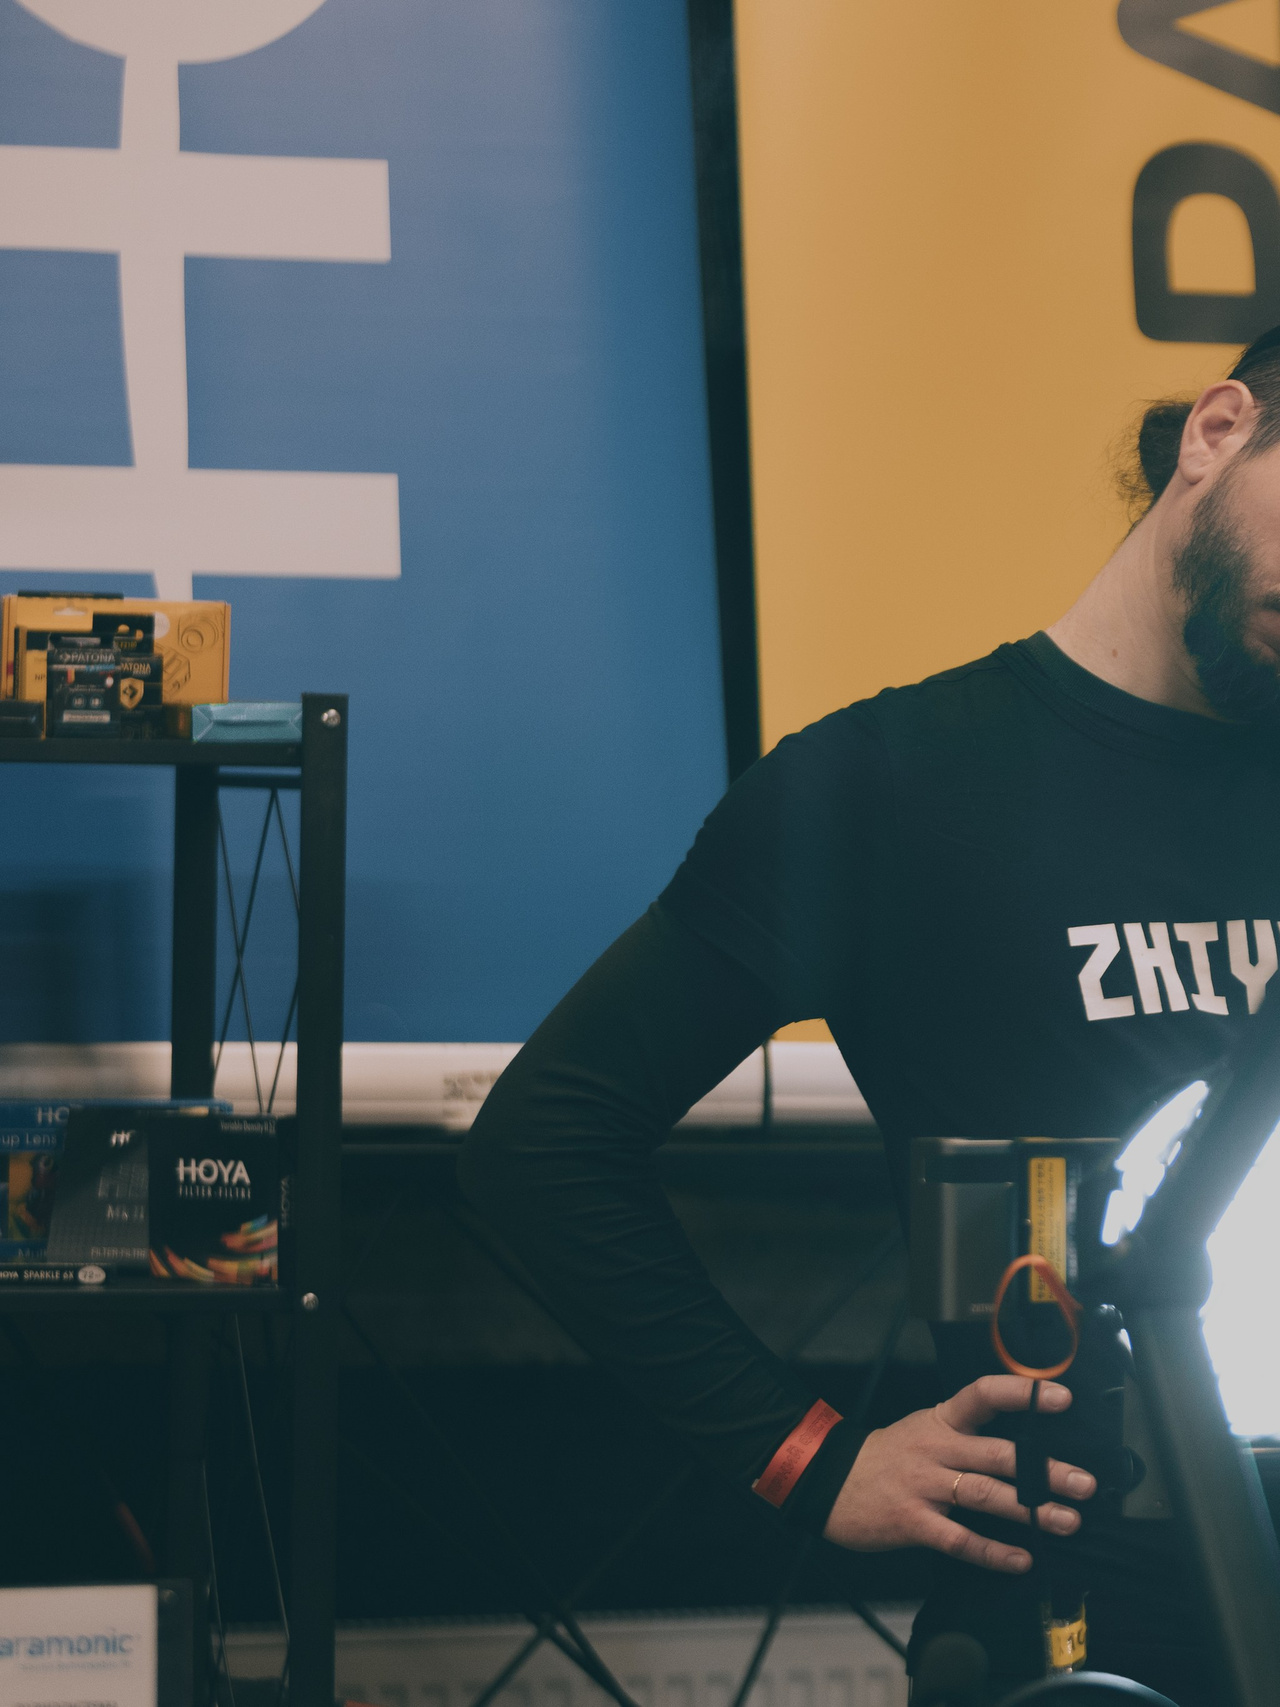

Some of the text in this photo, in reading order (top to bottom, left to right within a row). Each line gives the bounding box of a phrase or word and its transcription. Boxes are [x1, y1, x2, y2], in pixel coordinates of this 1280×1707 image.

[71, 652, 116, 663] PATONA
[26, 1132, 57, 1145] Lens
[177, 1158, 251, 1184] HOYA
[23, 1270, 60, 1280] SPARKLE
[62, 1270, 74, 1280] 6X
[0, 1625, 133, 1658] aramonic
